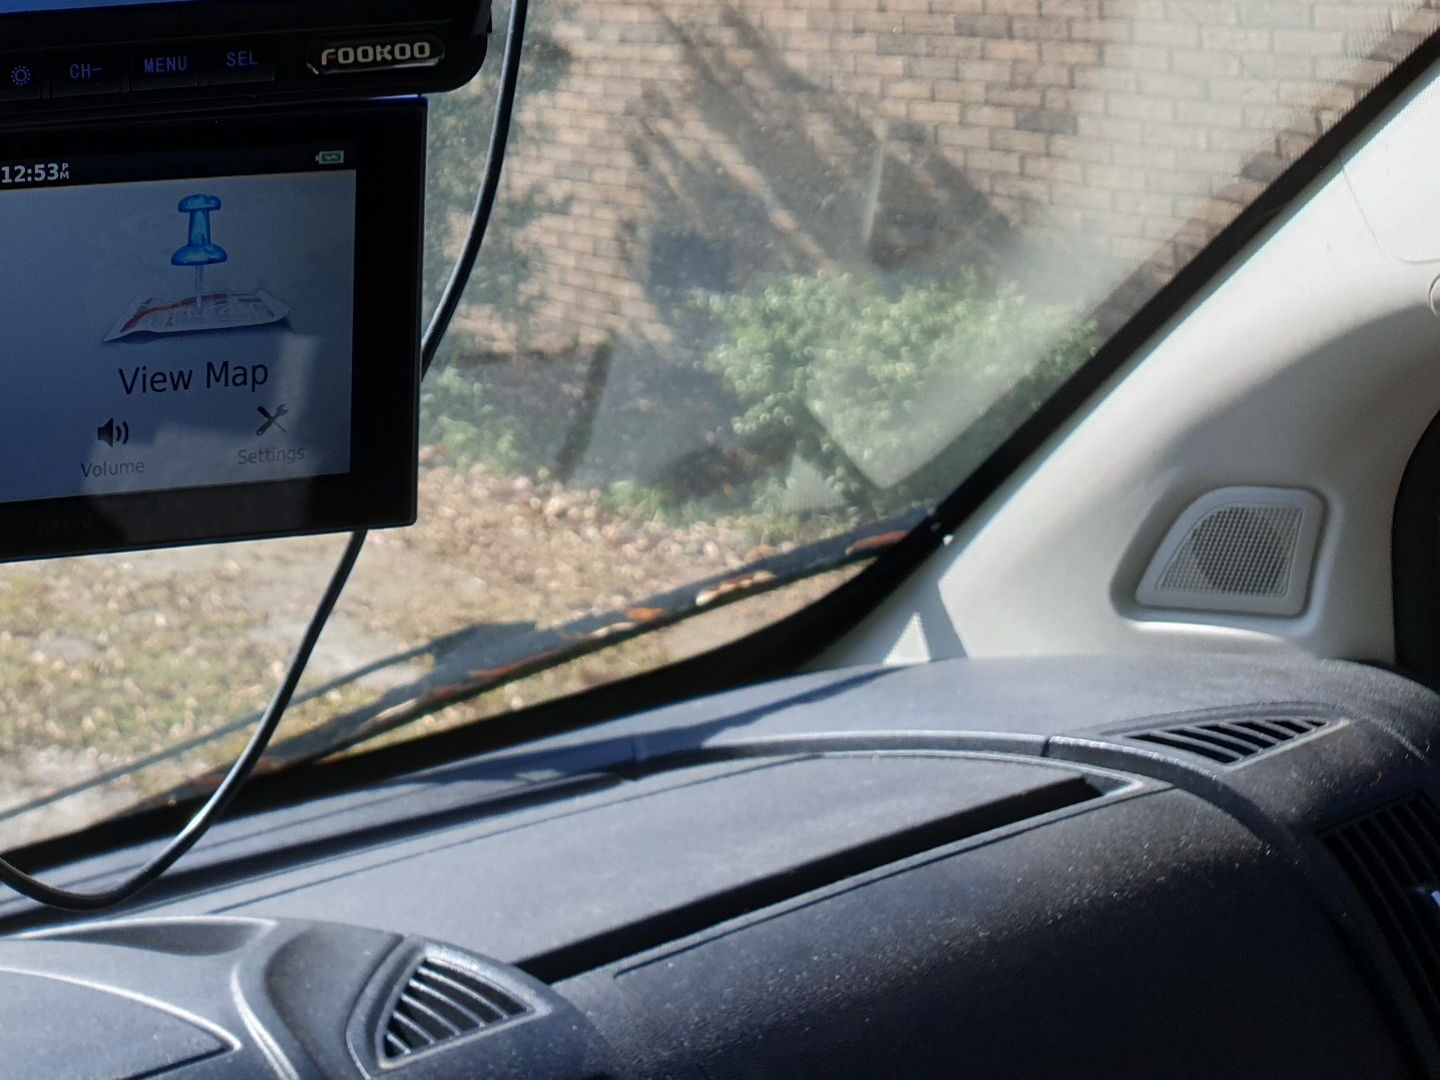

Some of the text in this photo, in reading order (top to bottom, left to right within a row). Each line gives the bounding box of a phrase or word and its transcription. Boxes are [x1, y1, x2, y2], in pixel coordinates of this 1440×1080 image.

[143, 55, 188, 73] MENU
[226, 50, 259, 67] SEL
[320, 41, 432, 66] FOOKOO
[1, 162, 59, 184] 12:53
[117, 359, 269, 396] View Map
[237, 445, 306, 466] Settings
[80, 459, 145, 479] Volume
